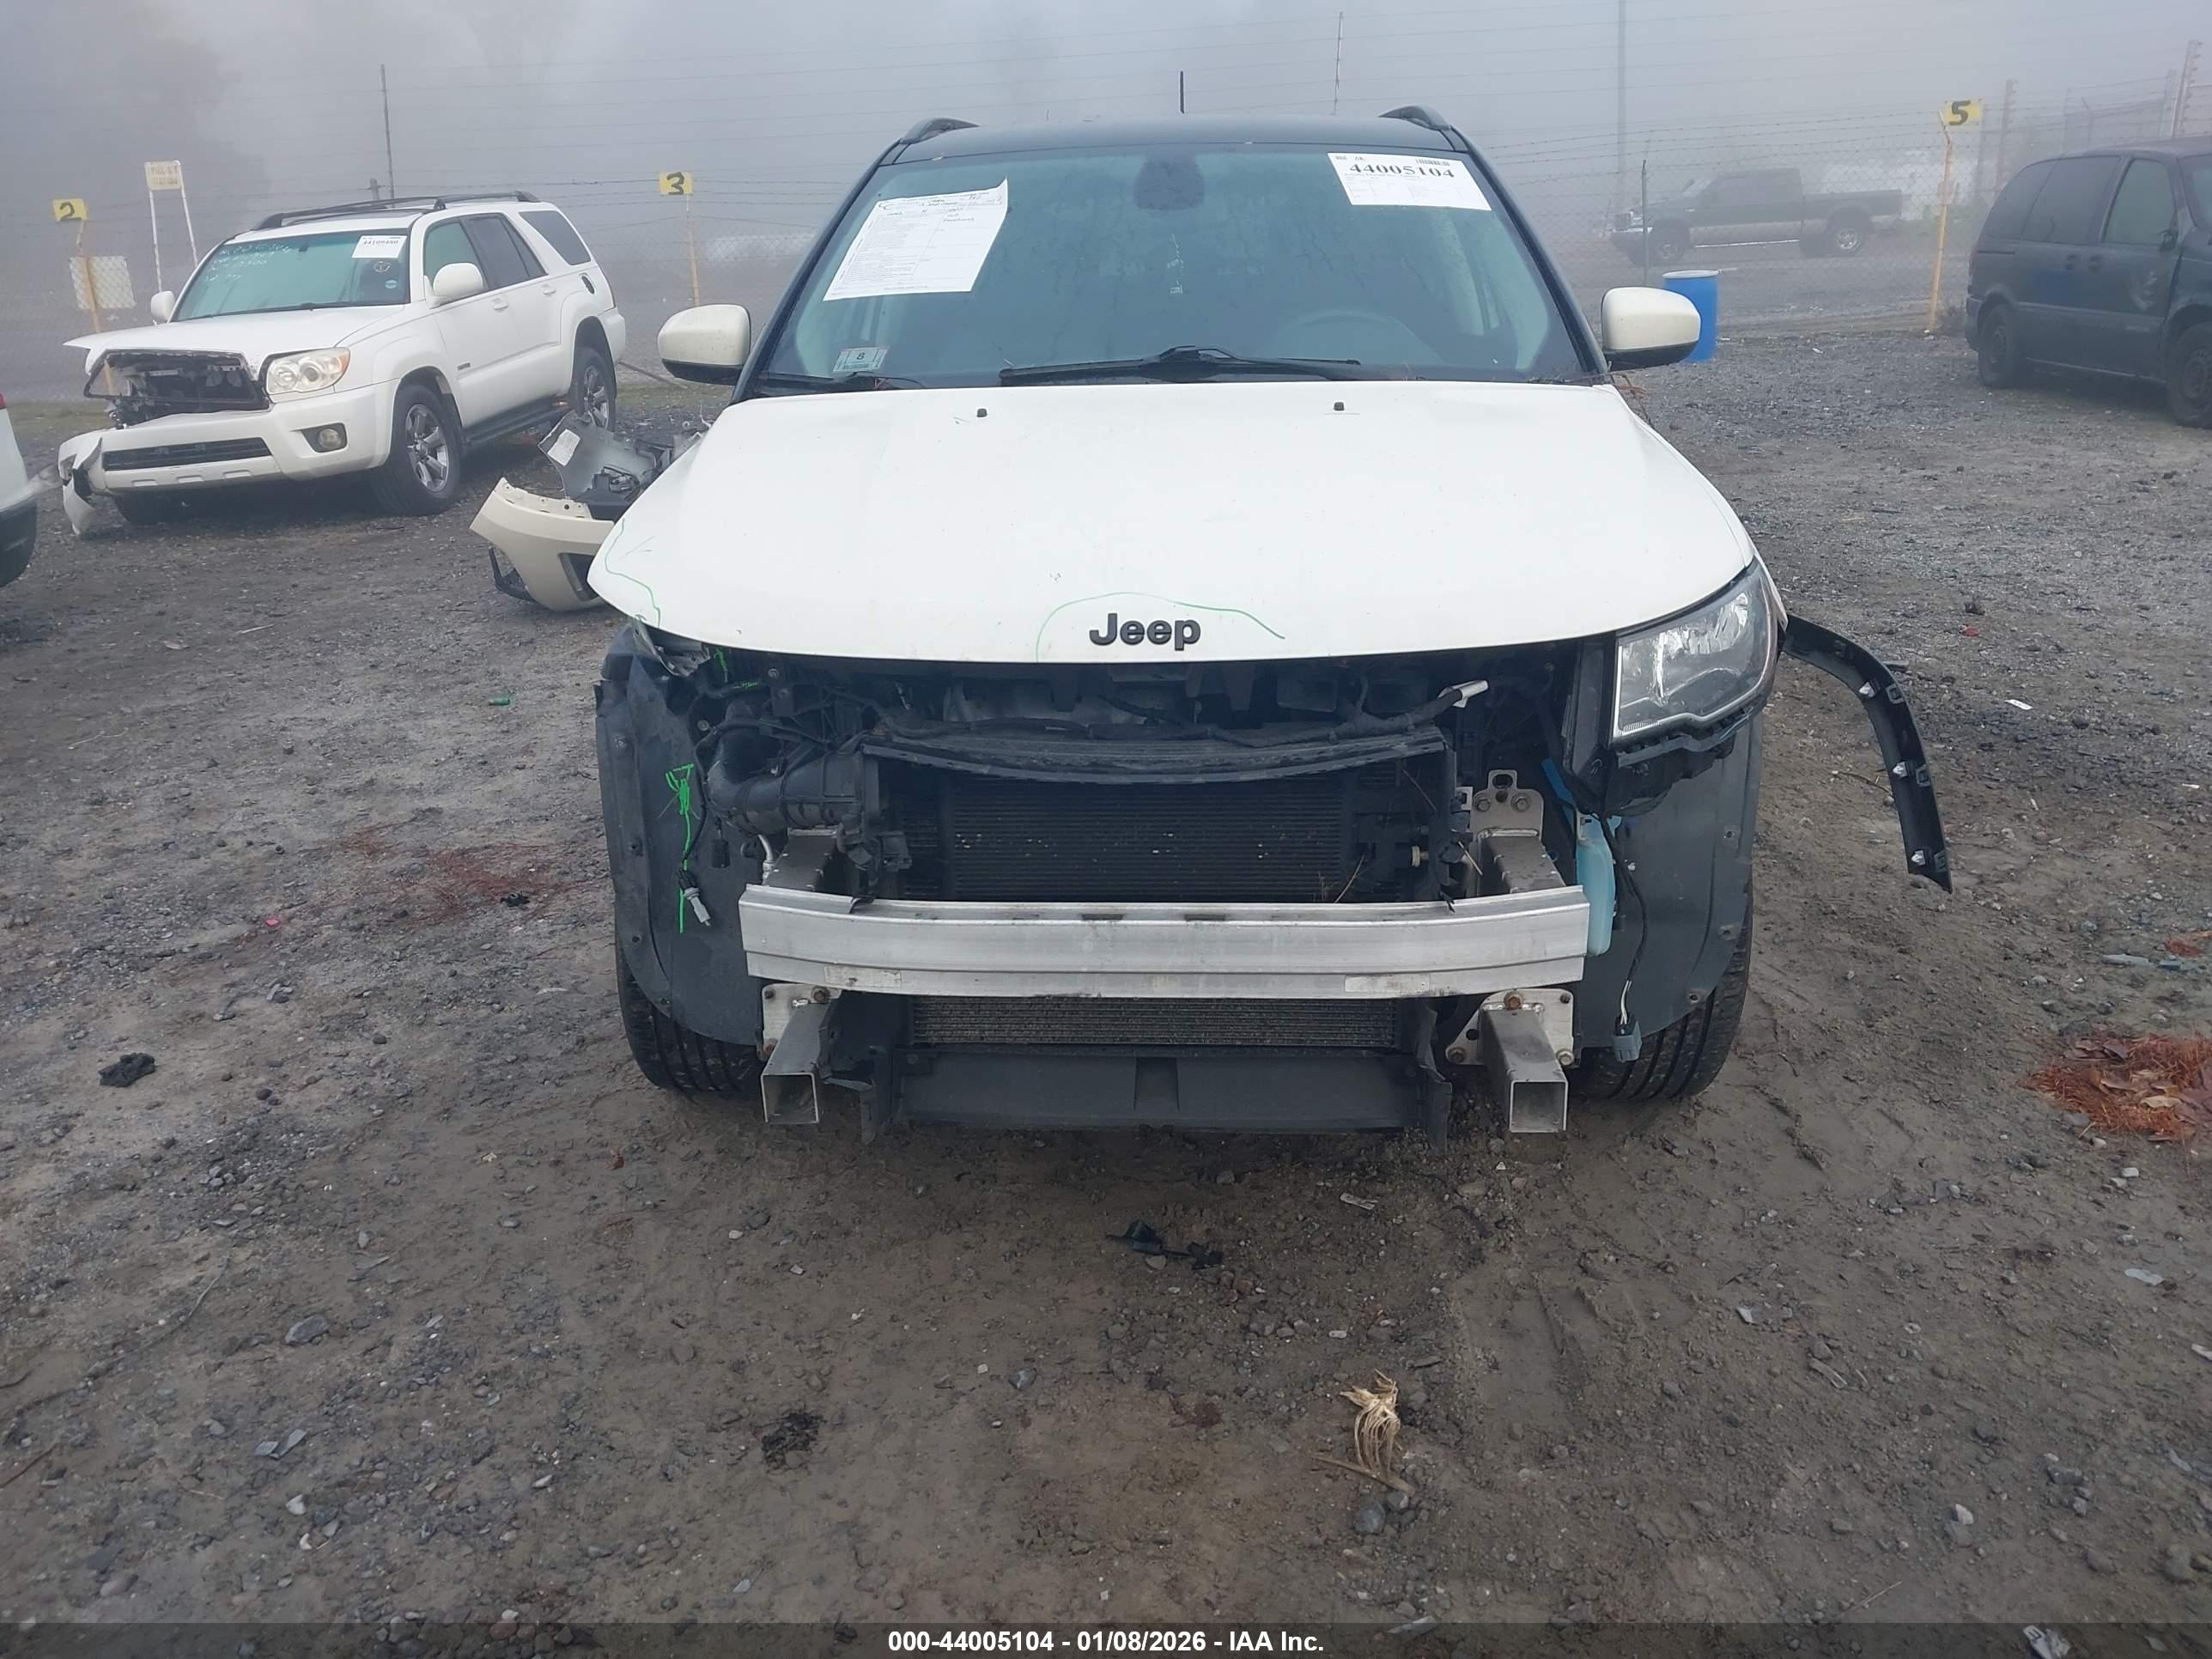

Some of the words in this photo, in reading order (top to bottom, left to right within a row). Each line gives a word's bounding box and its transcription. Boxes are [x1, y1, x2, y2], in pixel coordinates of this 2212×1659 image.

[1949, 100, 1971, 125] 5
[1349, 163, 1455, 178] 44005104
[665, 171, 684, 195] 3
[60, 202, 82, 221] 2
[856, 352, 866, 361] 8
[1089, 612, 1201, 651] Jeep
